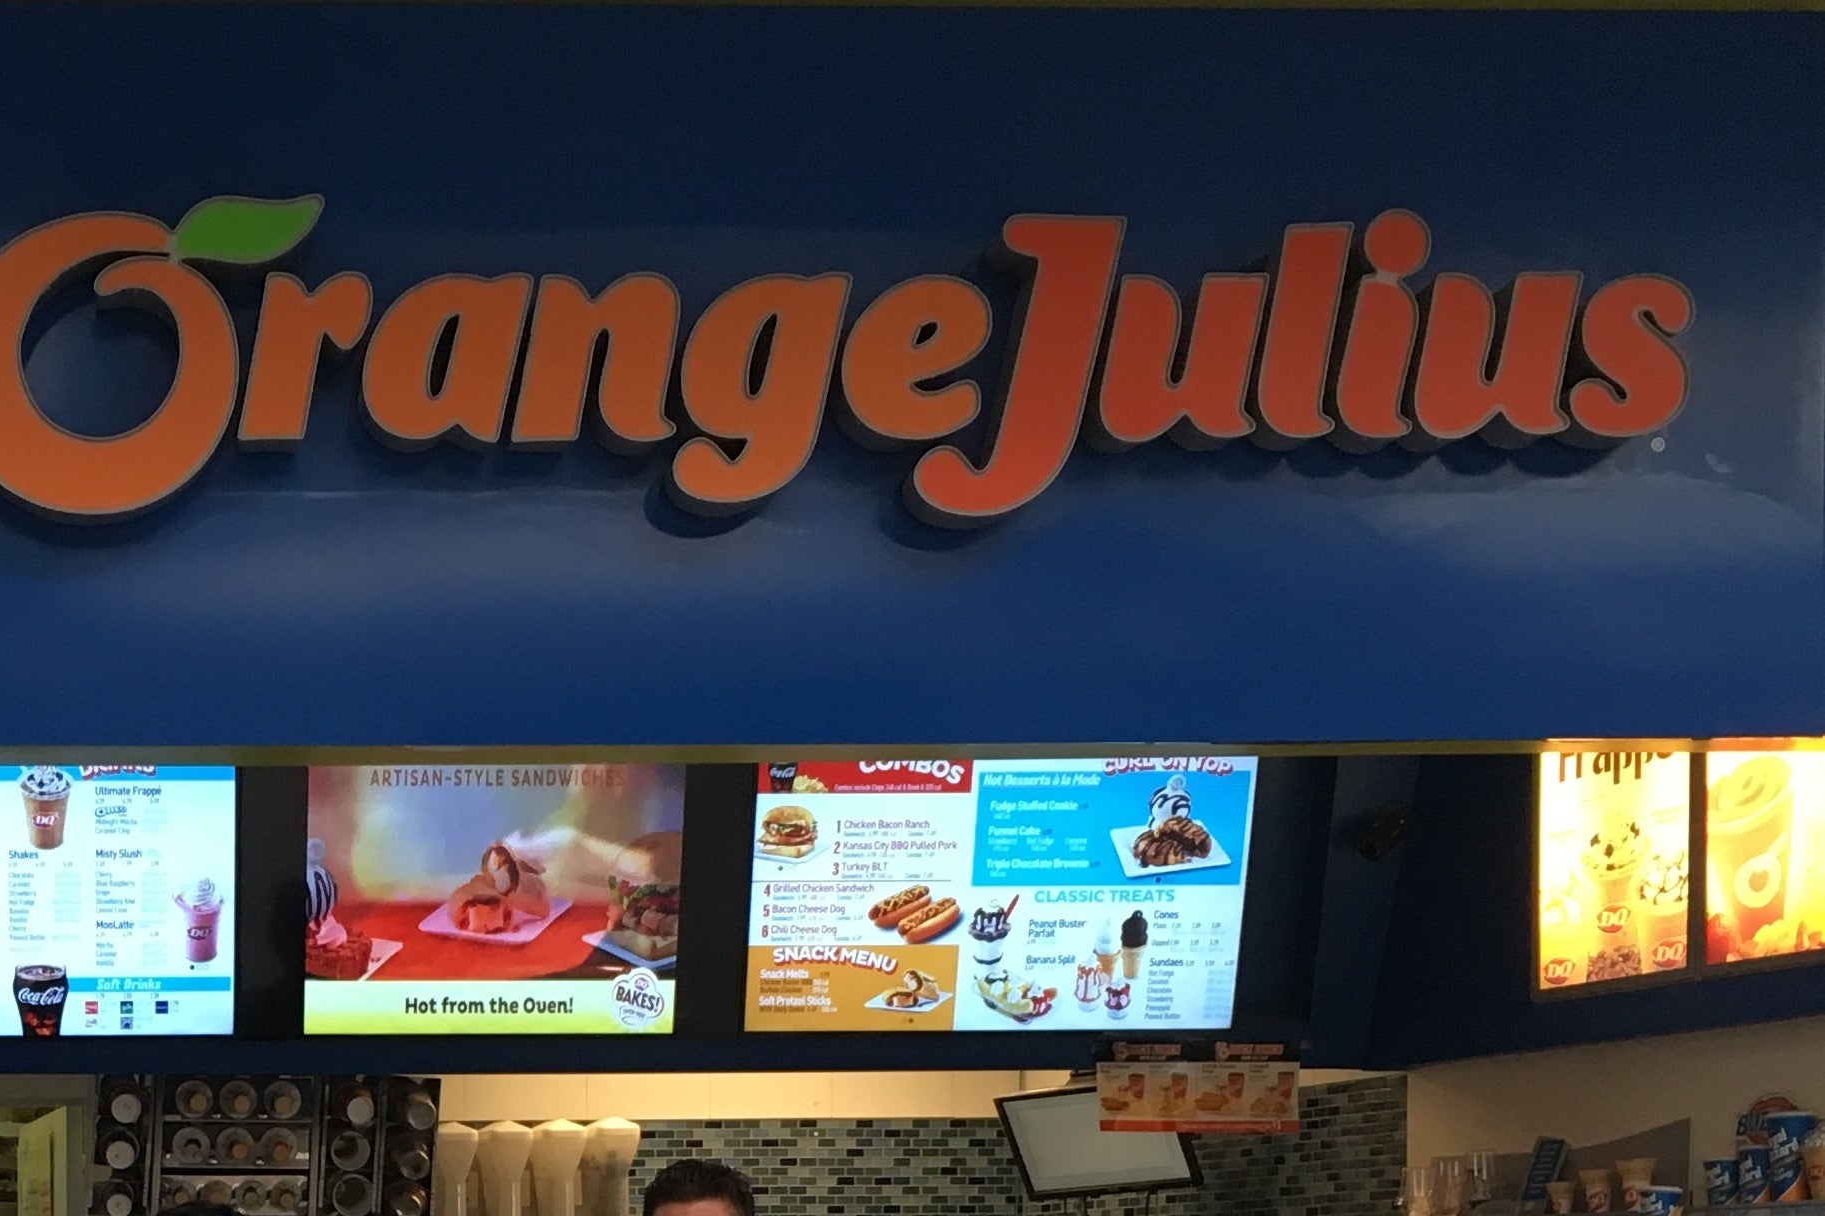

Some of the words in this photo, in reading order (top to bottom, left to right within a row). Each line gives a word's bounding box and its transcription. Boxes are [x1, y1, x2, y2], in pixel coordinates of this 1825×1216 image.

[370, 769, 505, 787] ARTISAN-STYLE
[511, 768, 624, 787] SANDWICHES
[983, 775, 1002, 786] Hot
[1004, 775, 1051, 786] Desserts
[1073, 775, 1101, 786] Mode
[95, 787, 131, 796] Ultimate
[132, 786, 161, 797] Frappé
[990, 801, 1016, 812] Fudge
[1017, 801, 1048, 811] Stuffed
[1049, 801, 1078, 811] Cookie
[836, 820, 841, 833] 1
[845, 820, 876, 829] Chicken
[878, 820, 903, 829] Bacon
[905, 820, 930, 829] Ranch
[1021, 826, 1041, 835] Cake
[833, 841, 840, 854] 2
[843, 841, 872, 850] Kansas
[874, 841, 889, 852] City
[891, 842, 908, 850] BBQ
[910, 842, 939, 850] Pulled
[941, 842, 957, 850] Pork
[9, 851, 39, 859] Shakes
[96, 850, 117, 860] Misty
[119, 850, 142, 858] Slush
[832, 863, 840, 875] 3
[842, 862, 870, 873] Turkey
[871, 862, 888, 871] BLT
[764, 885, 771, 897] 4
[773, 884, 800, 893] Grilled
[802, 884, 834, 893] Chicken
[836, 884, 874, 893] Sandwich
[1034, 890, 1105, 903] CLASSIC
[1109, 889, 1175, 902] TREATS
[763, 905, 770, 917] 5
[772, 905, 798, 913] Bacon
[800, 905, 828, 913] Cheese
[830, 905, 845, 915] Dog
[1154, 911, 1179, 919] Cones
[1059, 919, 1086, 928] Buster
[1601, 910, 1628, 926] DQ
[771, 925, 789, 934] Chili
[791, 925, 820, 934] Cheese
[822, 925, 837, 935] Dog
[1028, 929, 1055, 938] Parfait
[1653, 944, 1683, 960] DQ
[773, 948, 839, 964] SNACK
[840, 948, 897, 972] MENU
[1026, 955, 1056, 965] Banana
[1058, 955, 1075, 966] Split
[1150, 958, 1184, 967] Sundaes
[760, 970, 784, 979] Snack
[786, 970, 809, 979] Melts
[1547, 963, 1573, 978] DQ
[97, 979, 120, 990] Soft
[124, 979, 161, 990] Drinks
[615, 985, 660, 1012] BAKES!
[759, 996, 775, 1006] Soft
[776, 996, 805, 1006] Pretzel
[807, 996, 831, 1006] Sticks
[405, 997, 438, 1014] Hot
[442, 998, 484, 1014] from
[489, 997, 518, 1014] the
[522, 997, 573, 1014] Oven!
